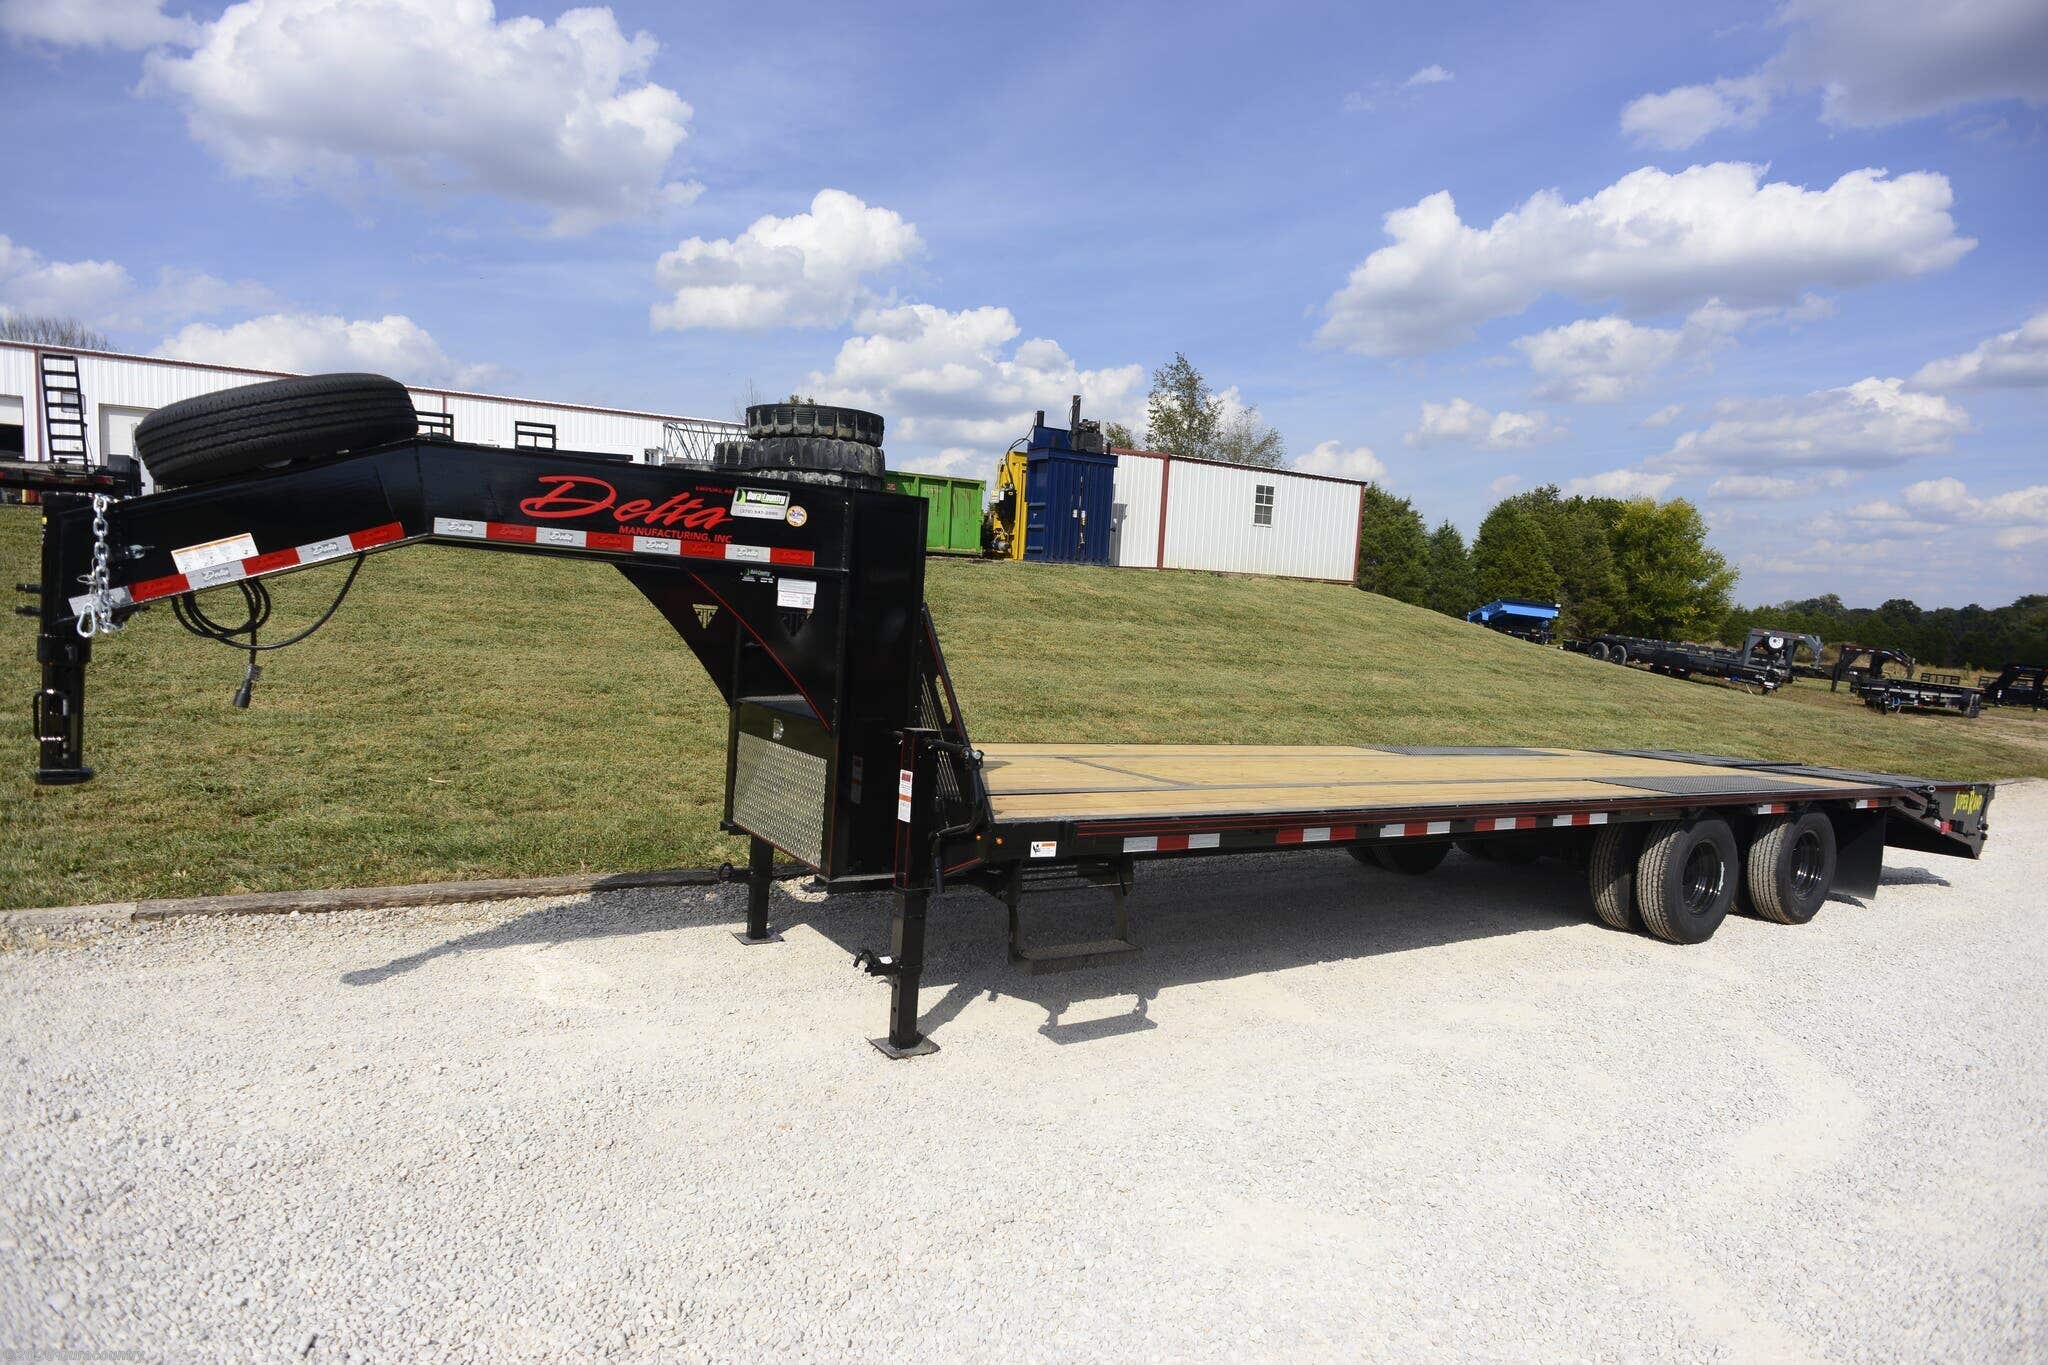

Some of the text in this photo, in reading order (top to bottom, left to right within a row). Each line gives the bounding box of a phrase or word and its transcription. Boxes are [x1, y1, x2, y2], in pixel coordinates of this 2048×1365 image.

[520, 475, 735, 530] Delta
[619, 526, 734, 544] MANUFACTURING, INC
